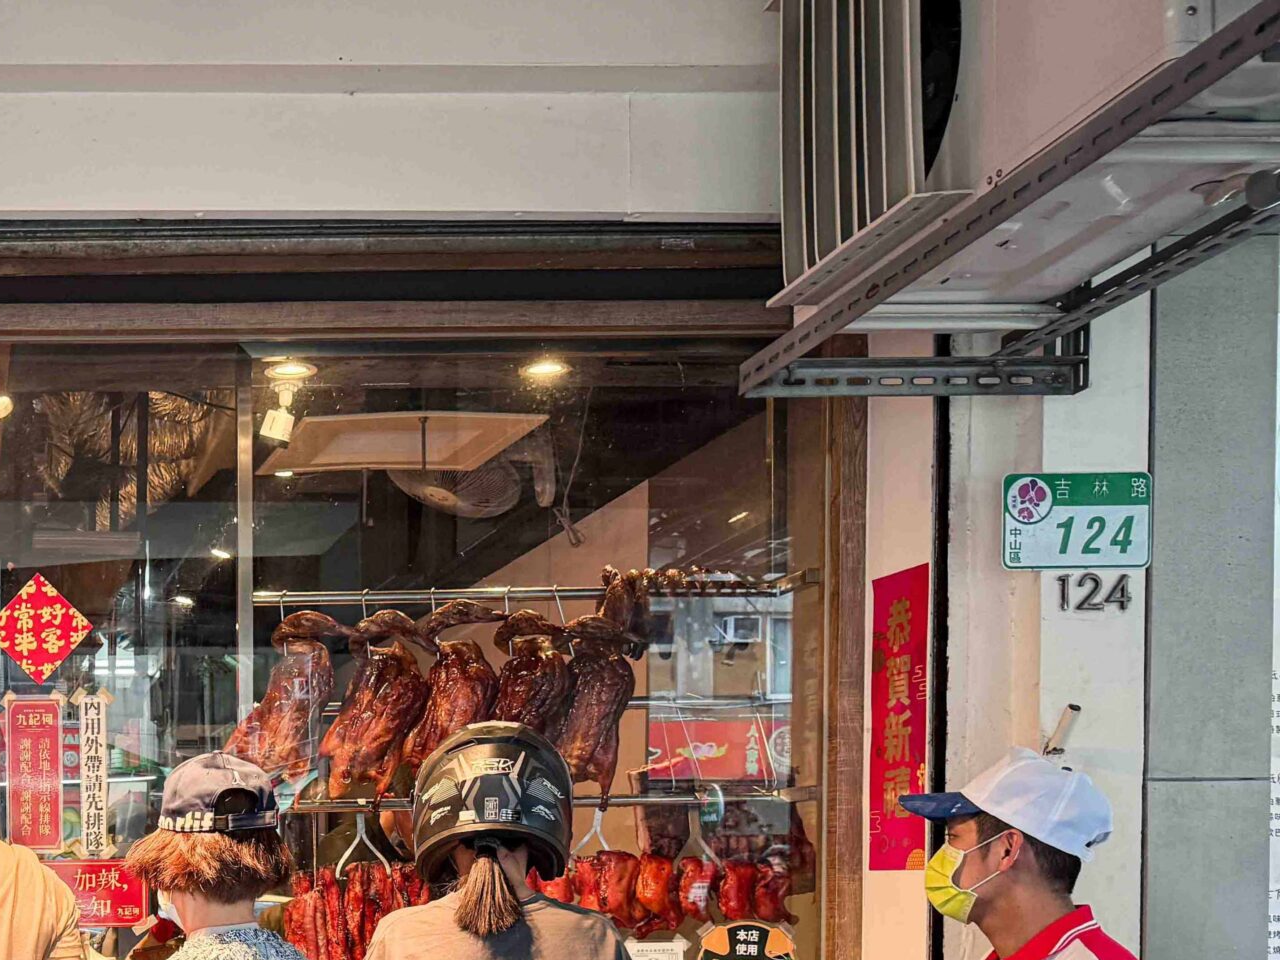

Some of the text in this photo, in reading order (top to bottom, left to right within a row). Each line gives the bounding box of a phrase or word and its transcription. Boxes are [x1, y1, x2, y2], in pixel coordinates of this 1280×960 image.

[1055, 478, 1147, 498] 吉林路
[1009, 527, 1022, 564] 中山區
[1056, 515, 1135, 555] 124
[1055, 573, 1133, 611] 124
[882, 597, 912, 820] 恭賀新禧
[735, 944, 758, 956] 使用
[736, 929, 760, 942] 本店
